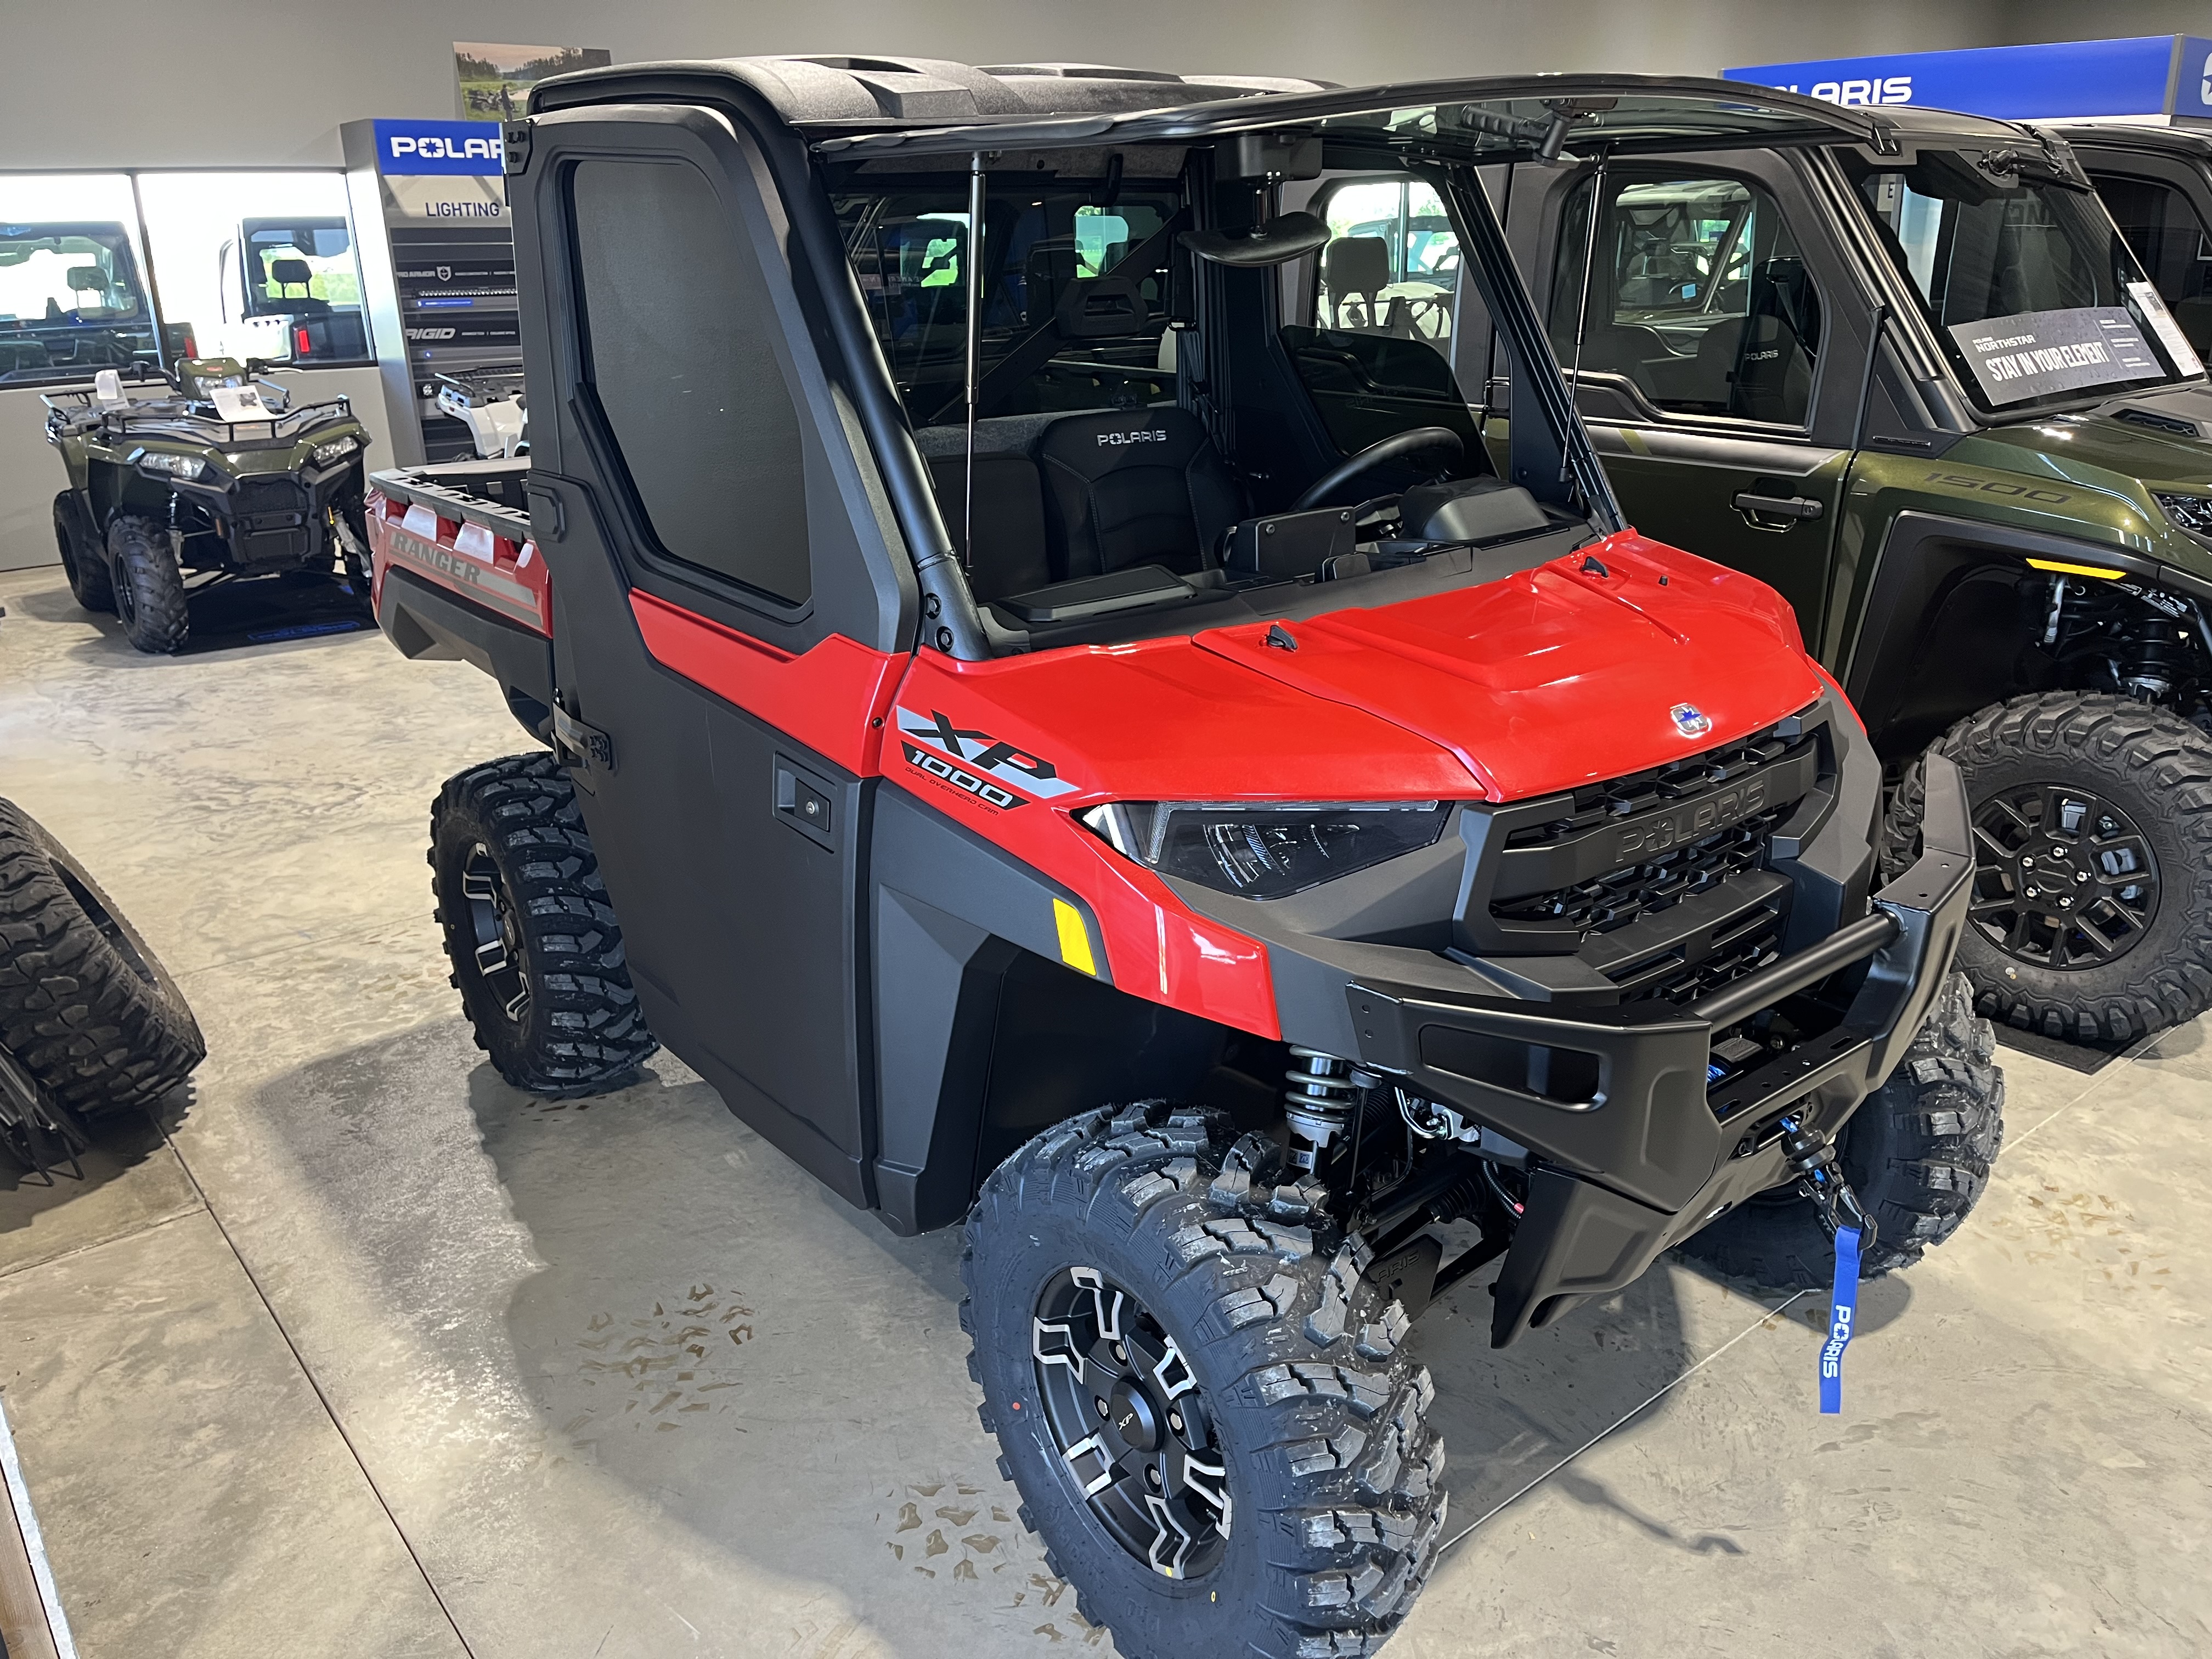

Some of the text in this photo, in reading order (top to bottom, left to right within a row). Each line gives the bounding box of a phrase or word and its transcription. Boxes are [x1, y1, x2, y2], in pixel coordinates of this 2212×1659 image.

[425, 202, 499, 217] LIGHTING
[1976, 335, 2036, 353] NORTHSTAR
[1985, 341, 2110, 382] STAY IN YOUR ELEMENT
[1097, 430, 1166, 446] POLARIS
[1924, 473, 2073, 504] 1500
[393, 532, 480, 585] RANGER
[901, 708, 1057, 781] XP
[905, 767, 927, 781] DUAL
[978, 803, 999, 816] CAM
[911, 750, 1014, 808] 1000
[1616, 780, 1764, 863] POLARIS
[1822, 1305, 1852, 1379] POLARIS
[1119, 1413, 1133, 1430] XP
